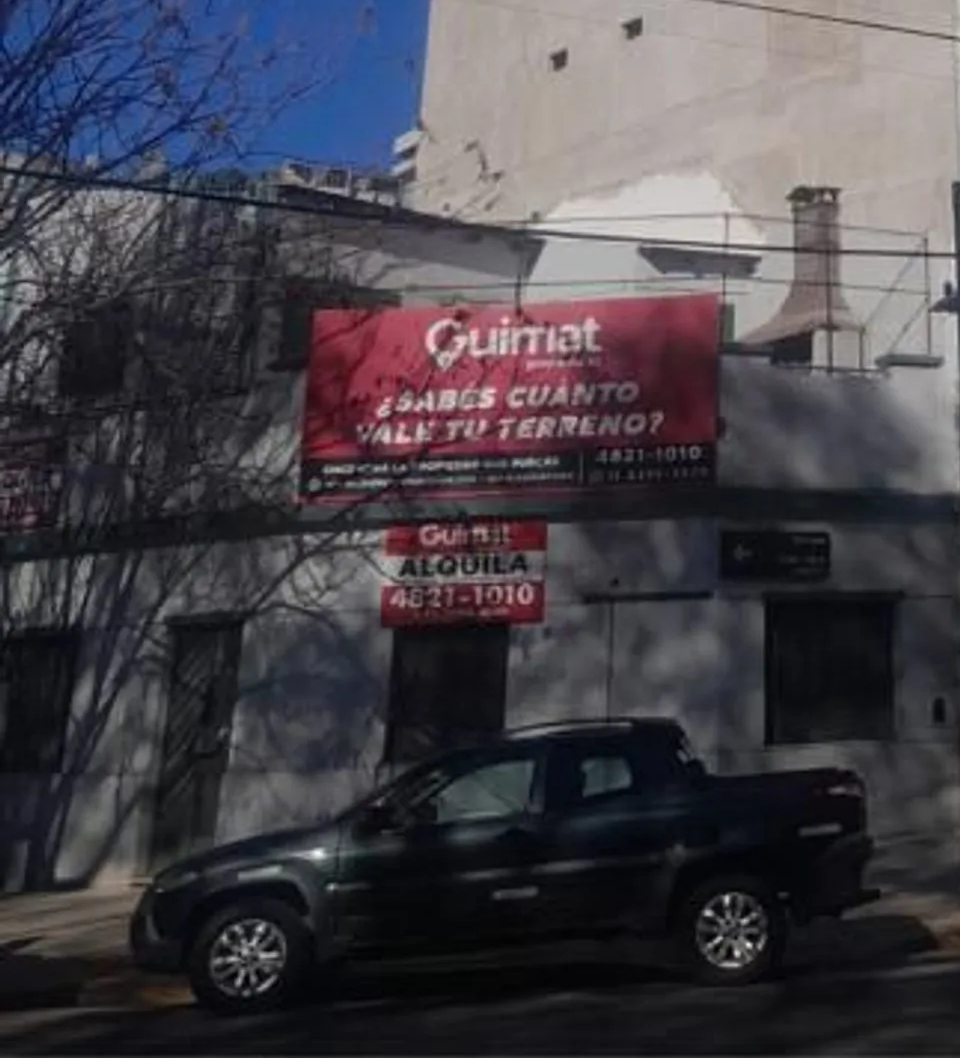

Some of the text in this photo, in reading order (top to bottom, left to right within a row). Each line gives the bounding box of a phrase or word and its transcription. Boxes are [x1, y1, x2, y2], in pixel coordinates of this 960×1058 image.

[425, 316, 602, 371] Guimat
[356, 410, 665, 445] VALE TU TERRENO?
[398, 553, 528, 577] ALQUILA
[389, 582, 535, 608] 4821-1010
